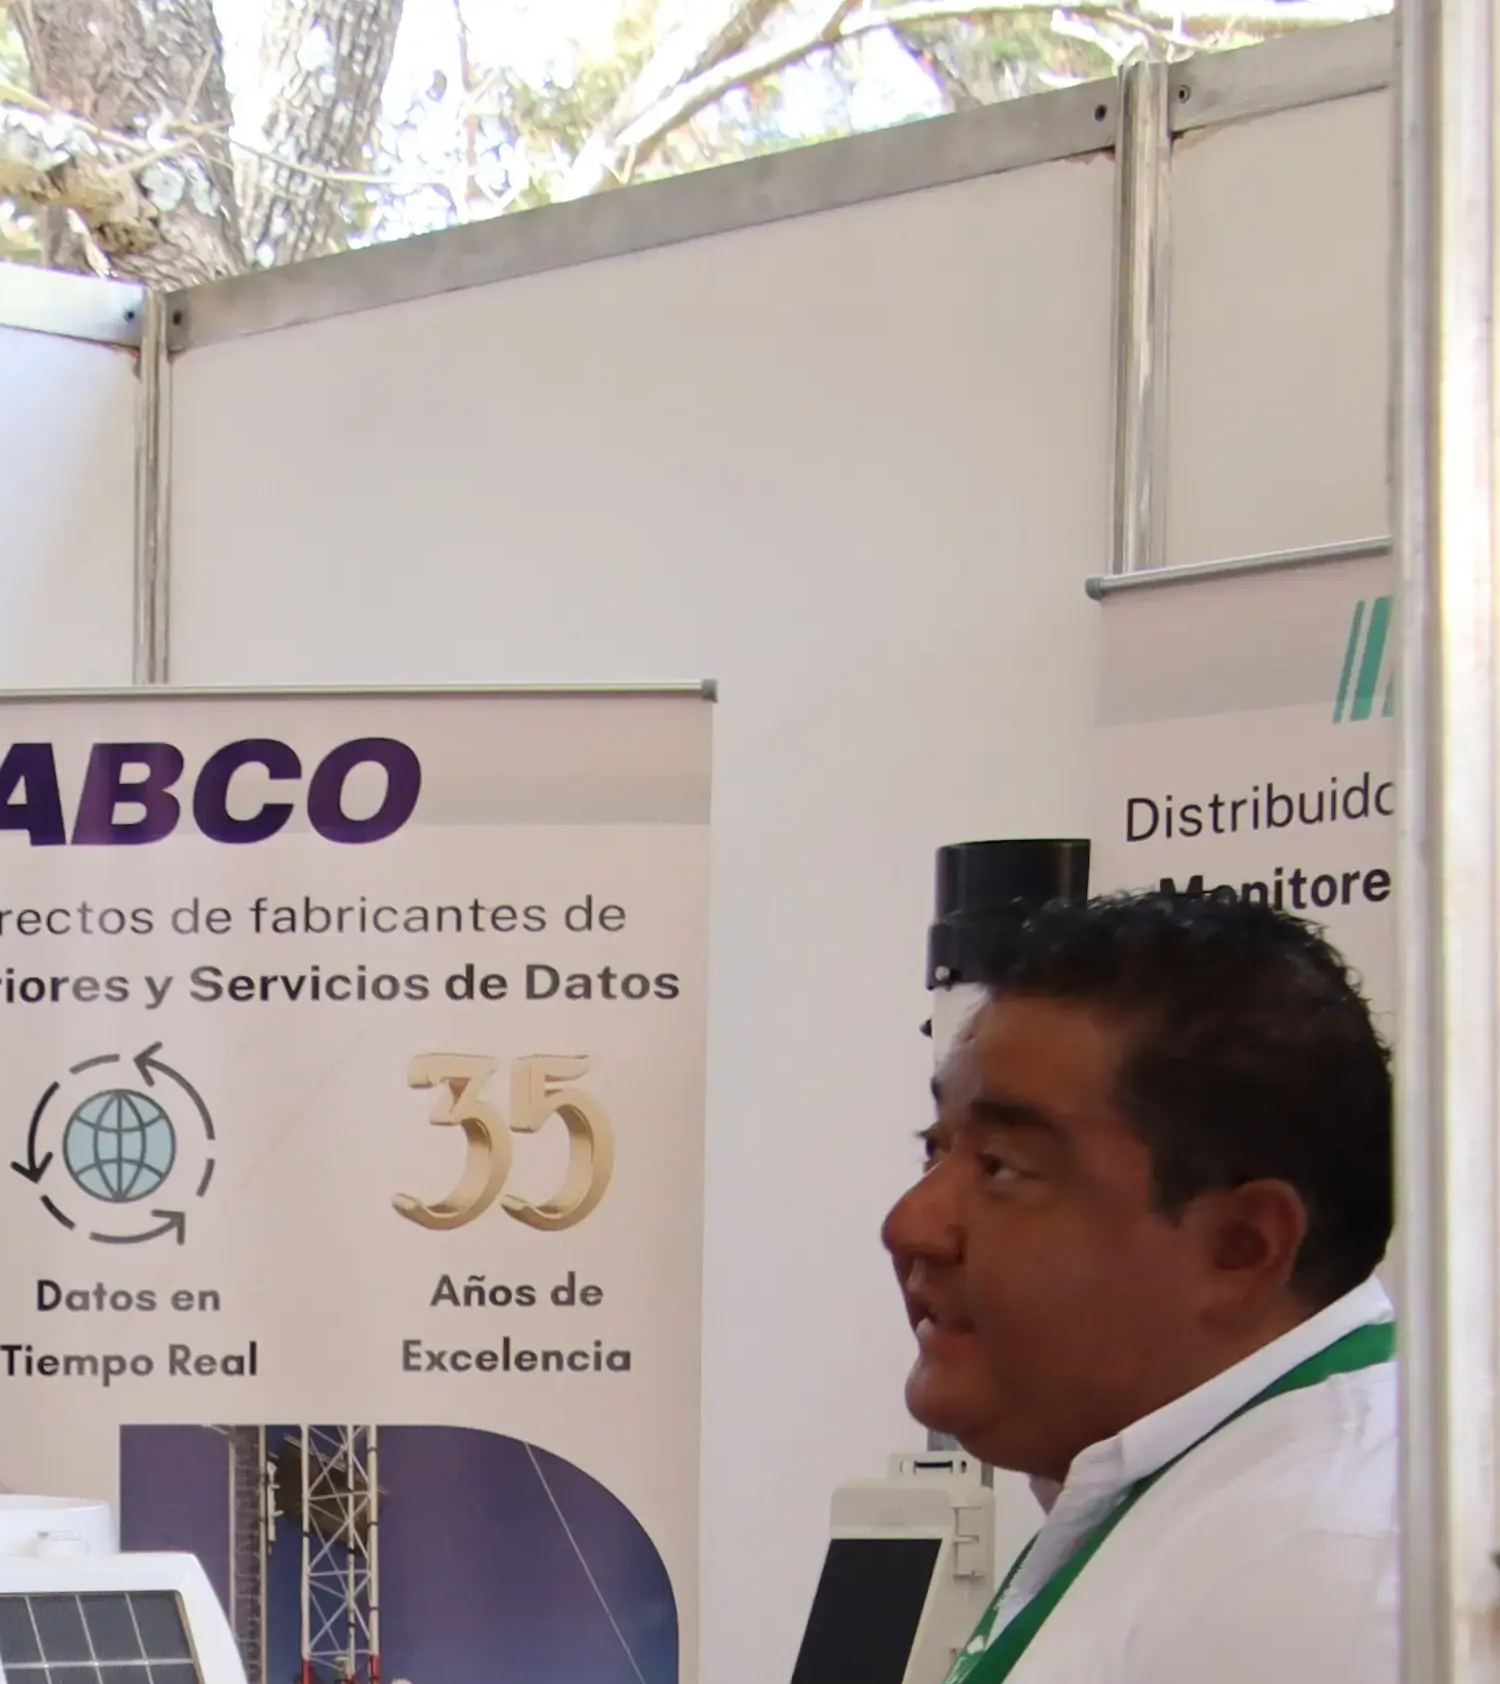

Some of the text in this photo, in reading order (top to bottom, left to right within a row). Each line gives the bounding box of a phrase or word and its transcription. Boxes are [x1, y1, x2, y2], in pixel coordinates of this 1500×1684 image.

[171, 897, 233, 936] de
[249, 895, 547, 934] fabricantes
[564, 893, 626, 932] de
[144, 975, 174, 1011] y
[190, 964, 430, 1002] Servicios
[445, 963, 508, 1001] de
[525, 962, 680, 1001] Datos
[391, 1053, 614, 1234] 35
[36, 1279, 221, 1312] Datos en
[430, 1273, 604, 1307] Años de
[0, 1340, 258, 1388] Tiempo Real
[402, 1335, 632, 1373] Excelencia
